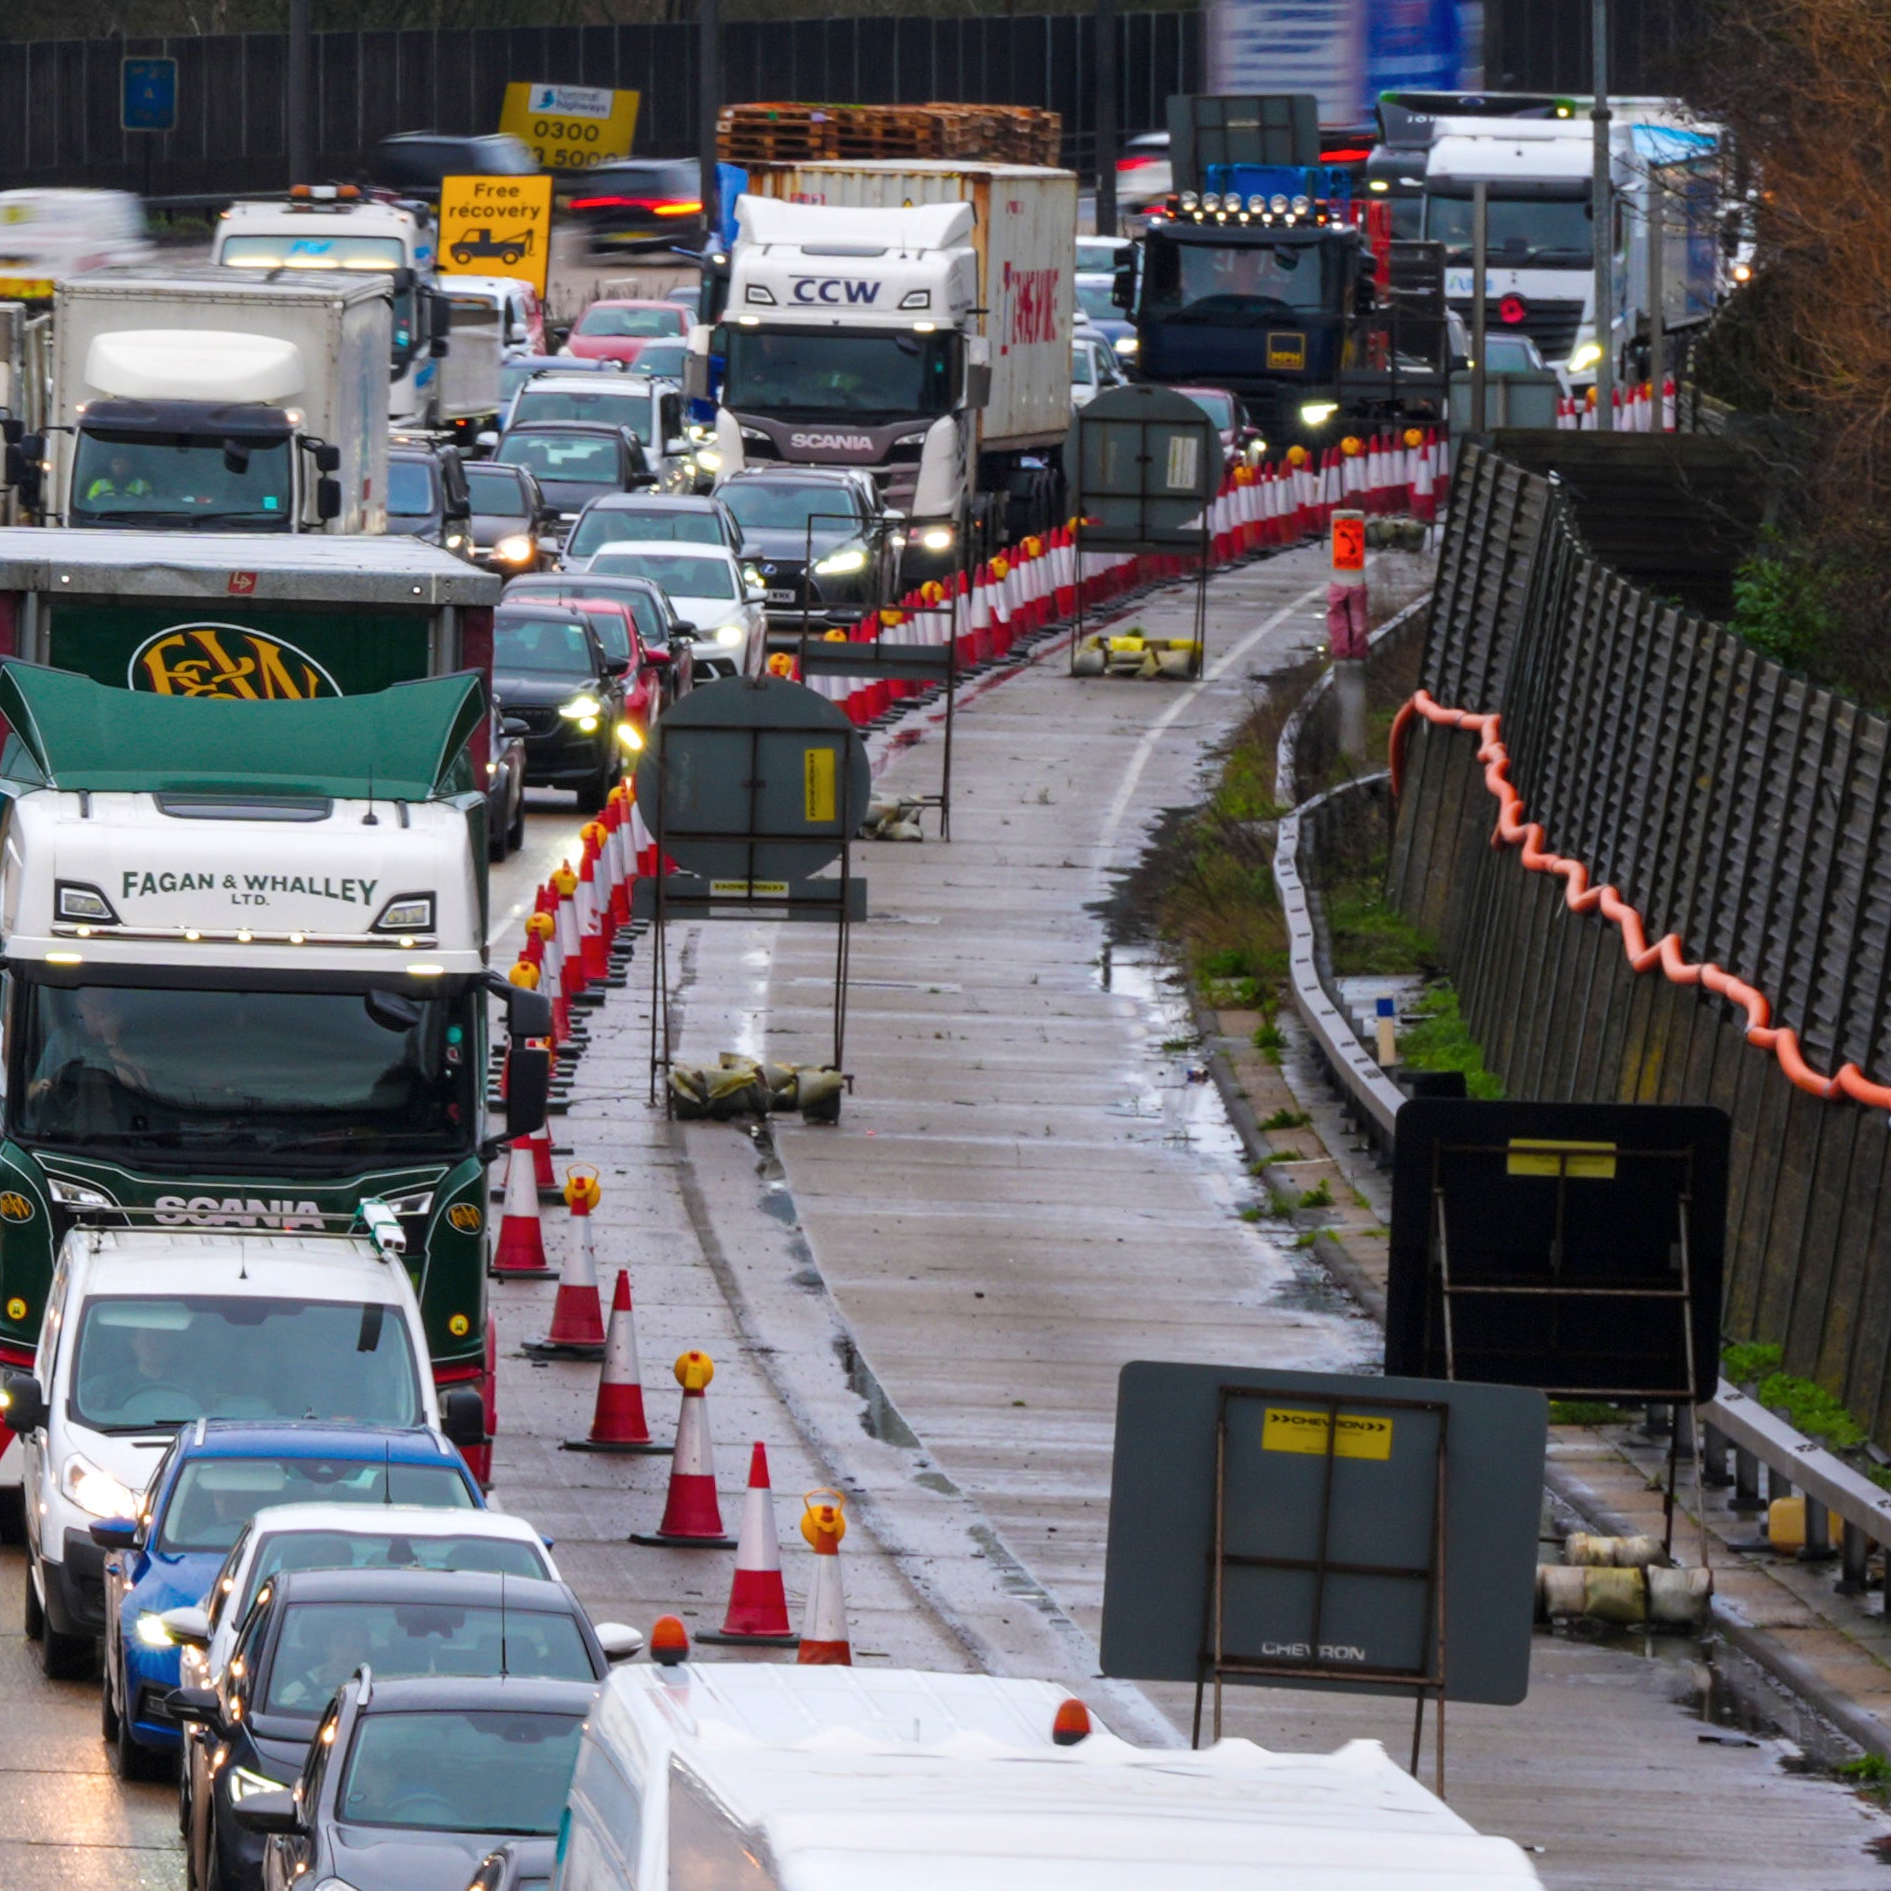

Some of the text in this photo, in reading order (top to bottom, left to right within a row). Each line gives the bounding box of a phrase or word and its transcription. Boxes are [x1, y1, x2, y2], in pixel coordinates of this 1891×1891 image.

[534, 120, 599, 142] 0300
[474, 183, 520, 198] Free
[448, 205, 541, 221] recovery
[793, 279, 881, 304] CCW
[790, 433, 873, 450] SCANIA
[122, 871, 378, 907] FAGAN & WHALLEY
[153, 1195, 325, 1229] SCANIA
